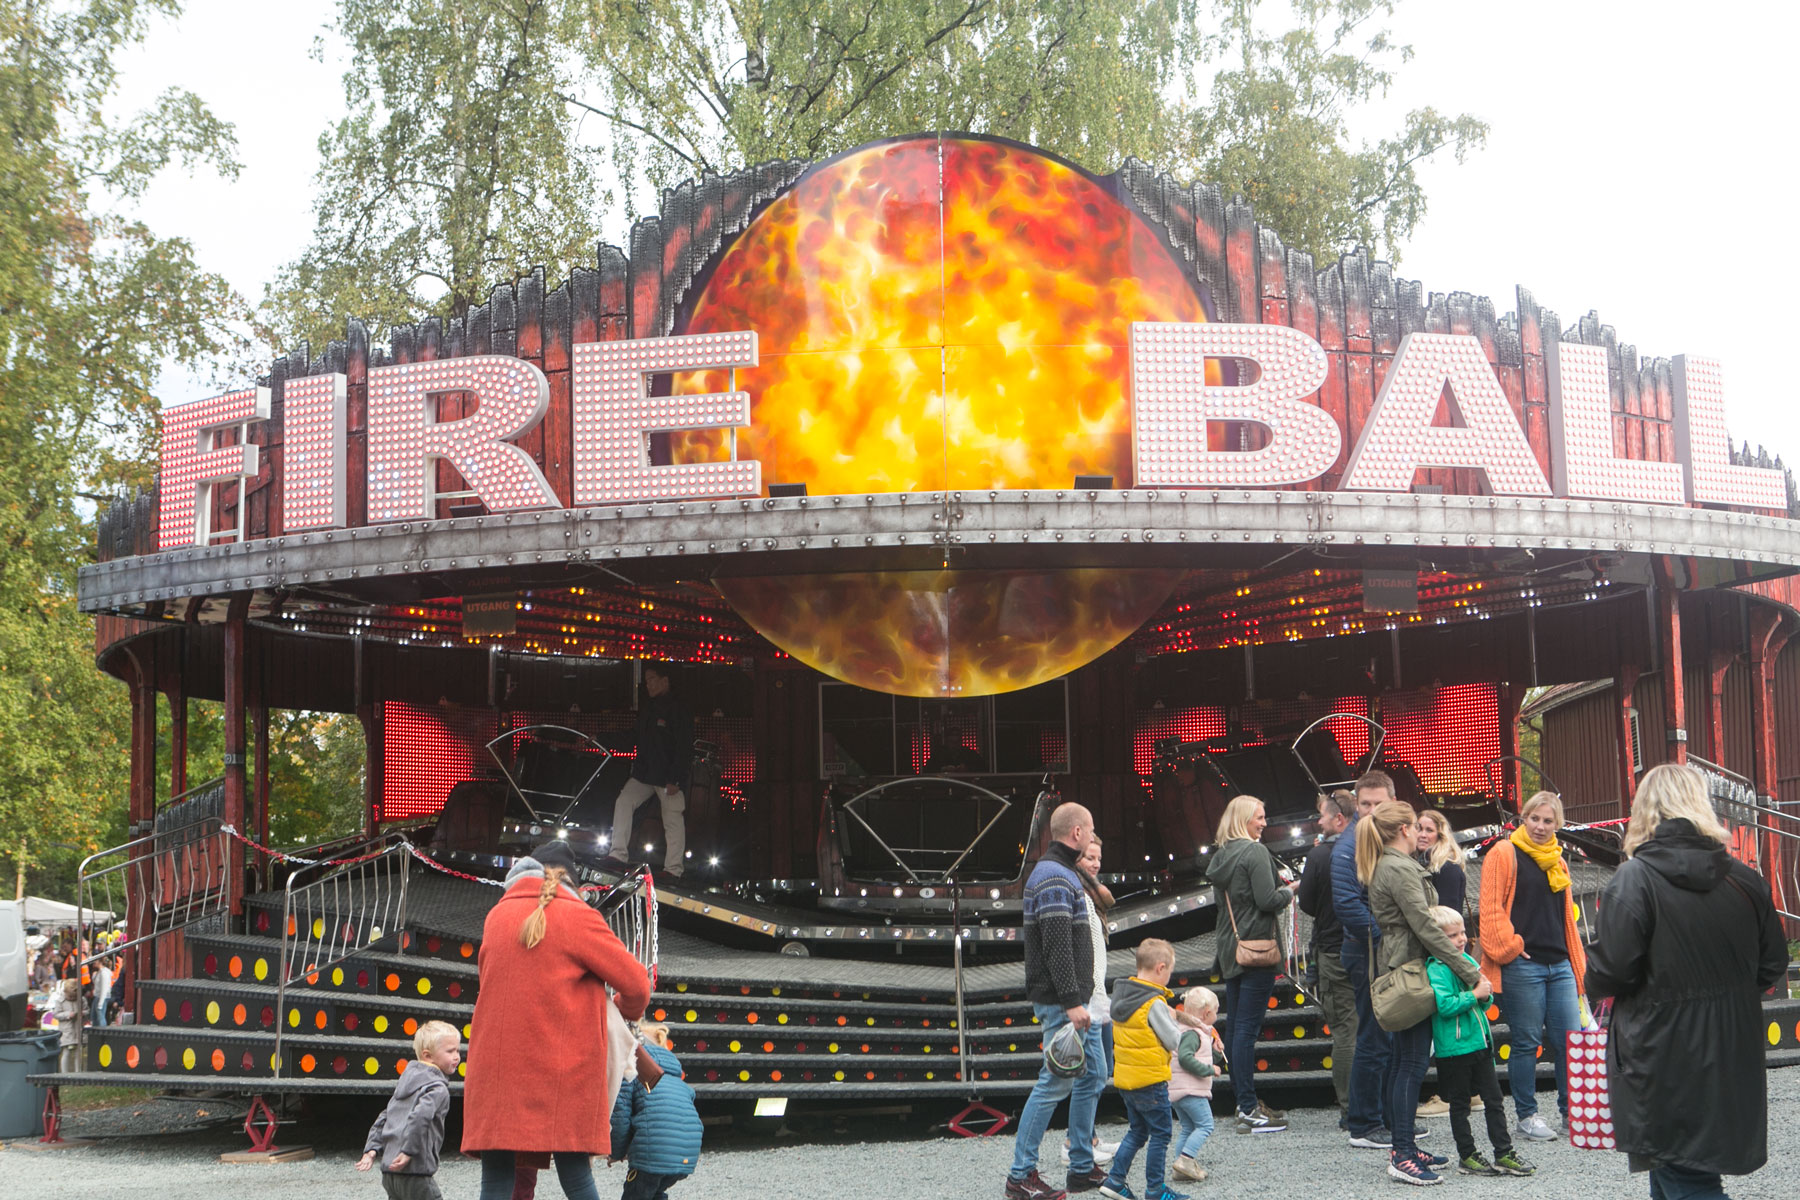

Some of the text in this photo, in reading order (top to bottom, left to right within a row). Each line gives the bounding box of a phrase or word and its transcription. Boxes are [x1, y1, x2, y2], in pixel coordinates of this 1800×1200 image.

[158, 321, 1786, 549] FIRE BALL
[1367, 577, 1413, 589] UTGANG
[466, 600, 511, 613] UTGANG
